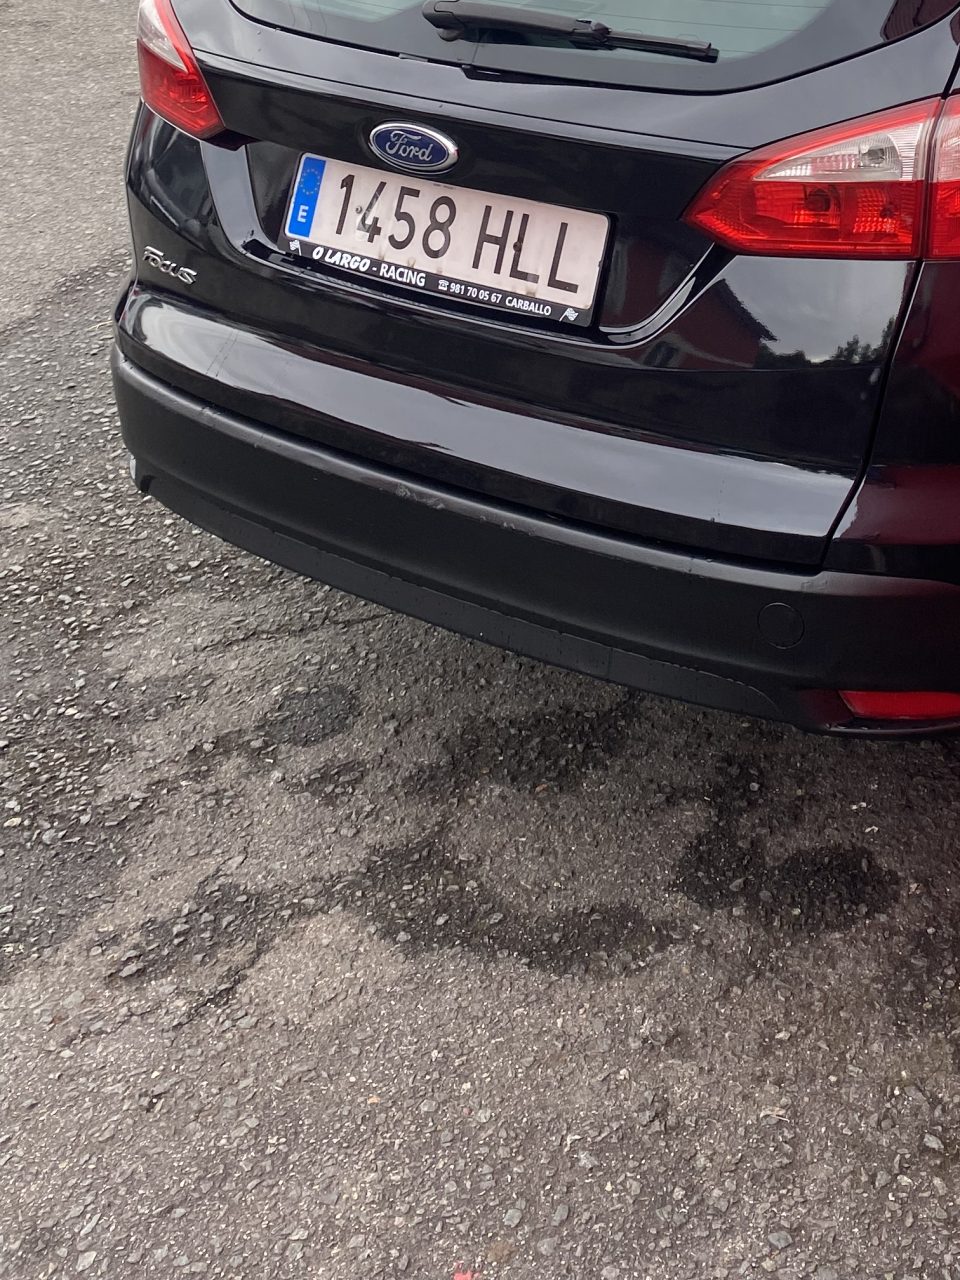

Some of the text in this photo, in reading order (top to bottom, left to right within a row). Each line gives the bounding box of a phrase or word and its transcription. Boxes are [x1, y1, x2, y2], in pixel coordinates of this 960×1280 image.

[385, 130, 434, 161] Ford
[297, 205, 309, 223] E
[335, 174, 579, 294] 1458 HLL
[312, 246, 324, 260] O
[324, 249, 371, 272] LARGO
[379, 263, 426, 287] RACING
[450, 283, 465, 296] 981
[467, 286, 478, 298] 70
[478, 289, 489, 301] 05
[491, 291, 502, 303] 67
[505, 296, 552, 317] CARBALLO
